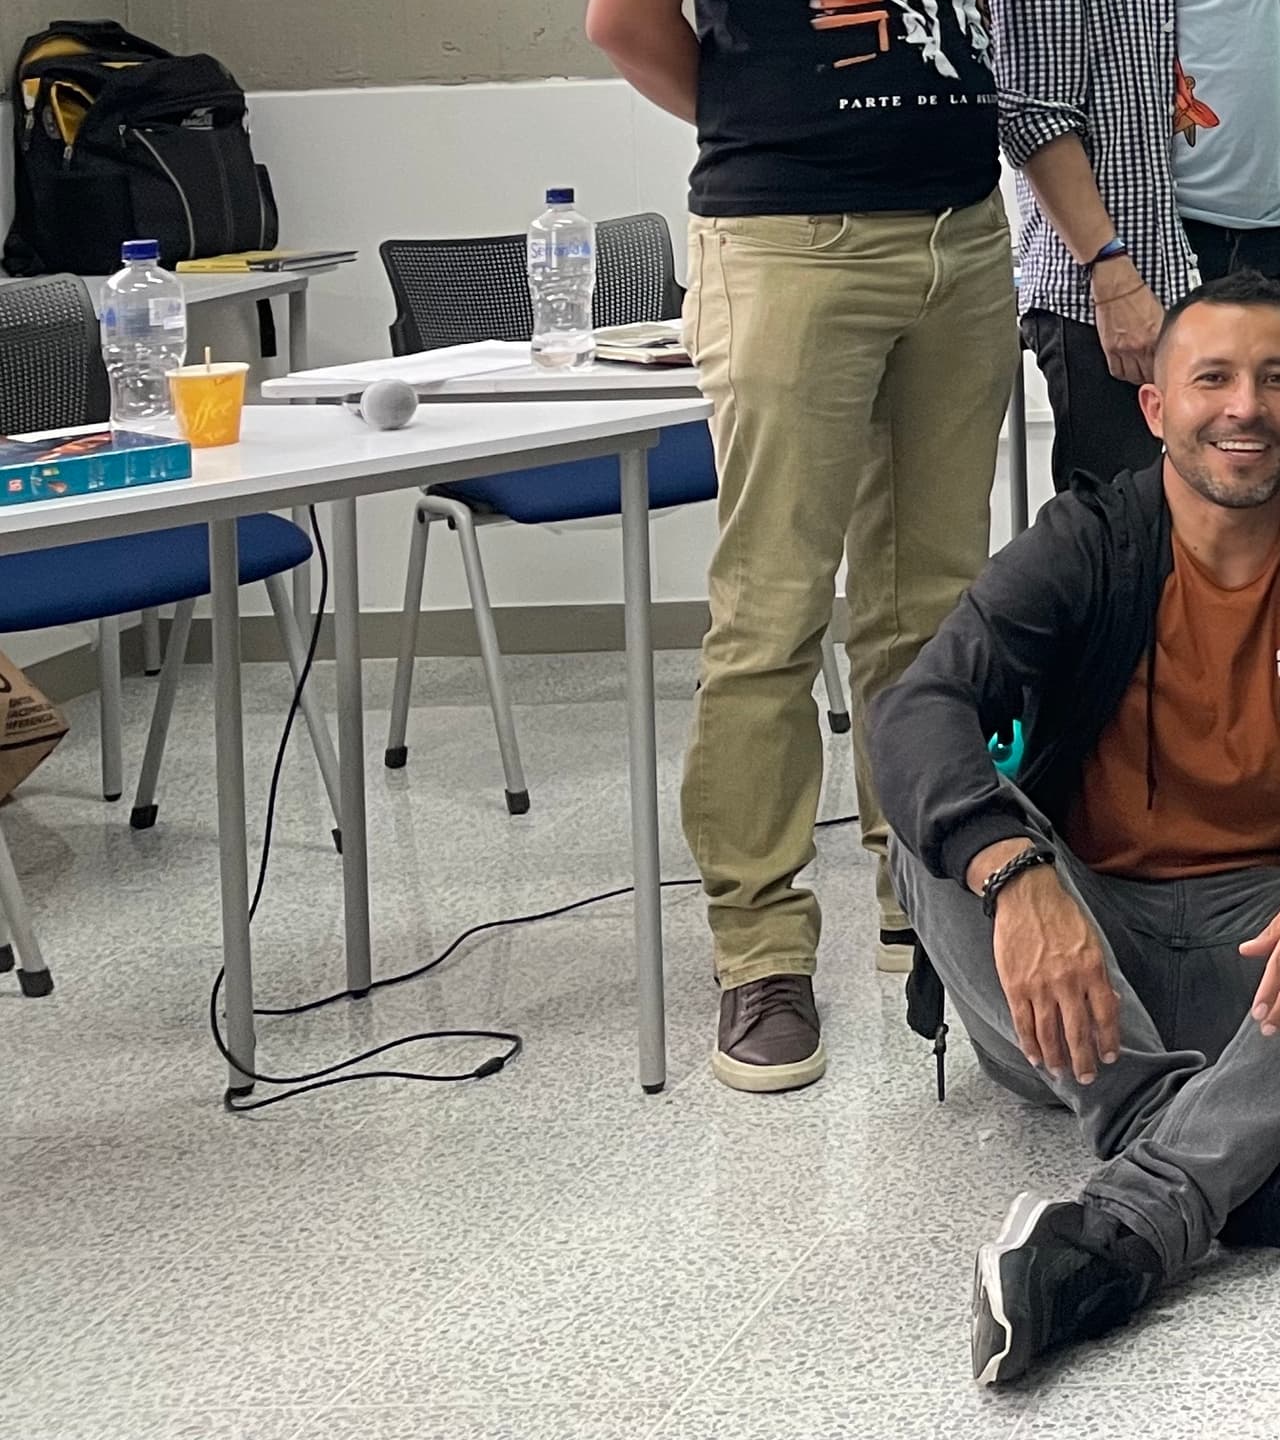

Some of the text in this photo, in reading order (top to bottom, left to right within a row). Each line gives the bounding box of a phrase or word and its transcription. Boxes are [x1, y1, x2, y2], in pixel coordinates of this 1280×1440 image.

[838, 95, 902, 110] PARTE
[917, 94, 938, 106] DE
[949, 94, 968, 105] LA
